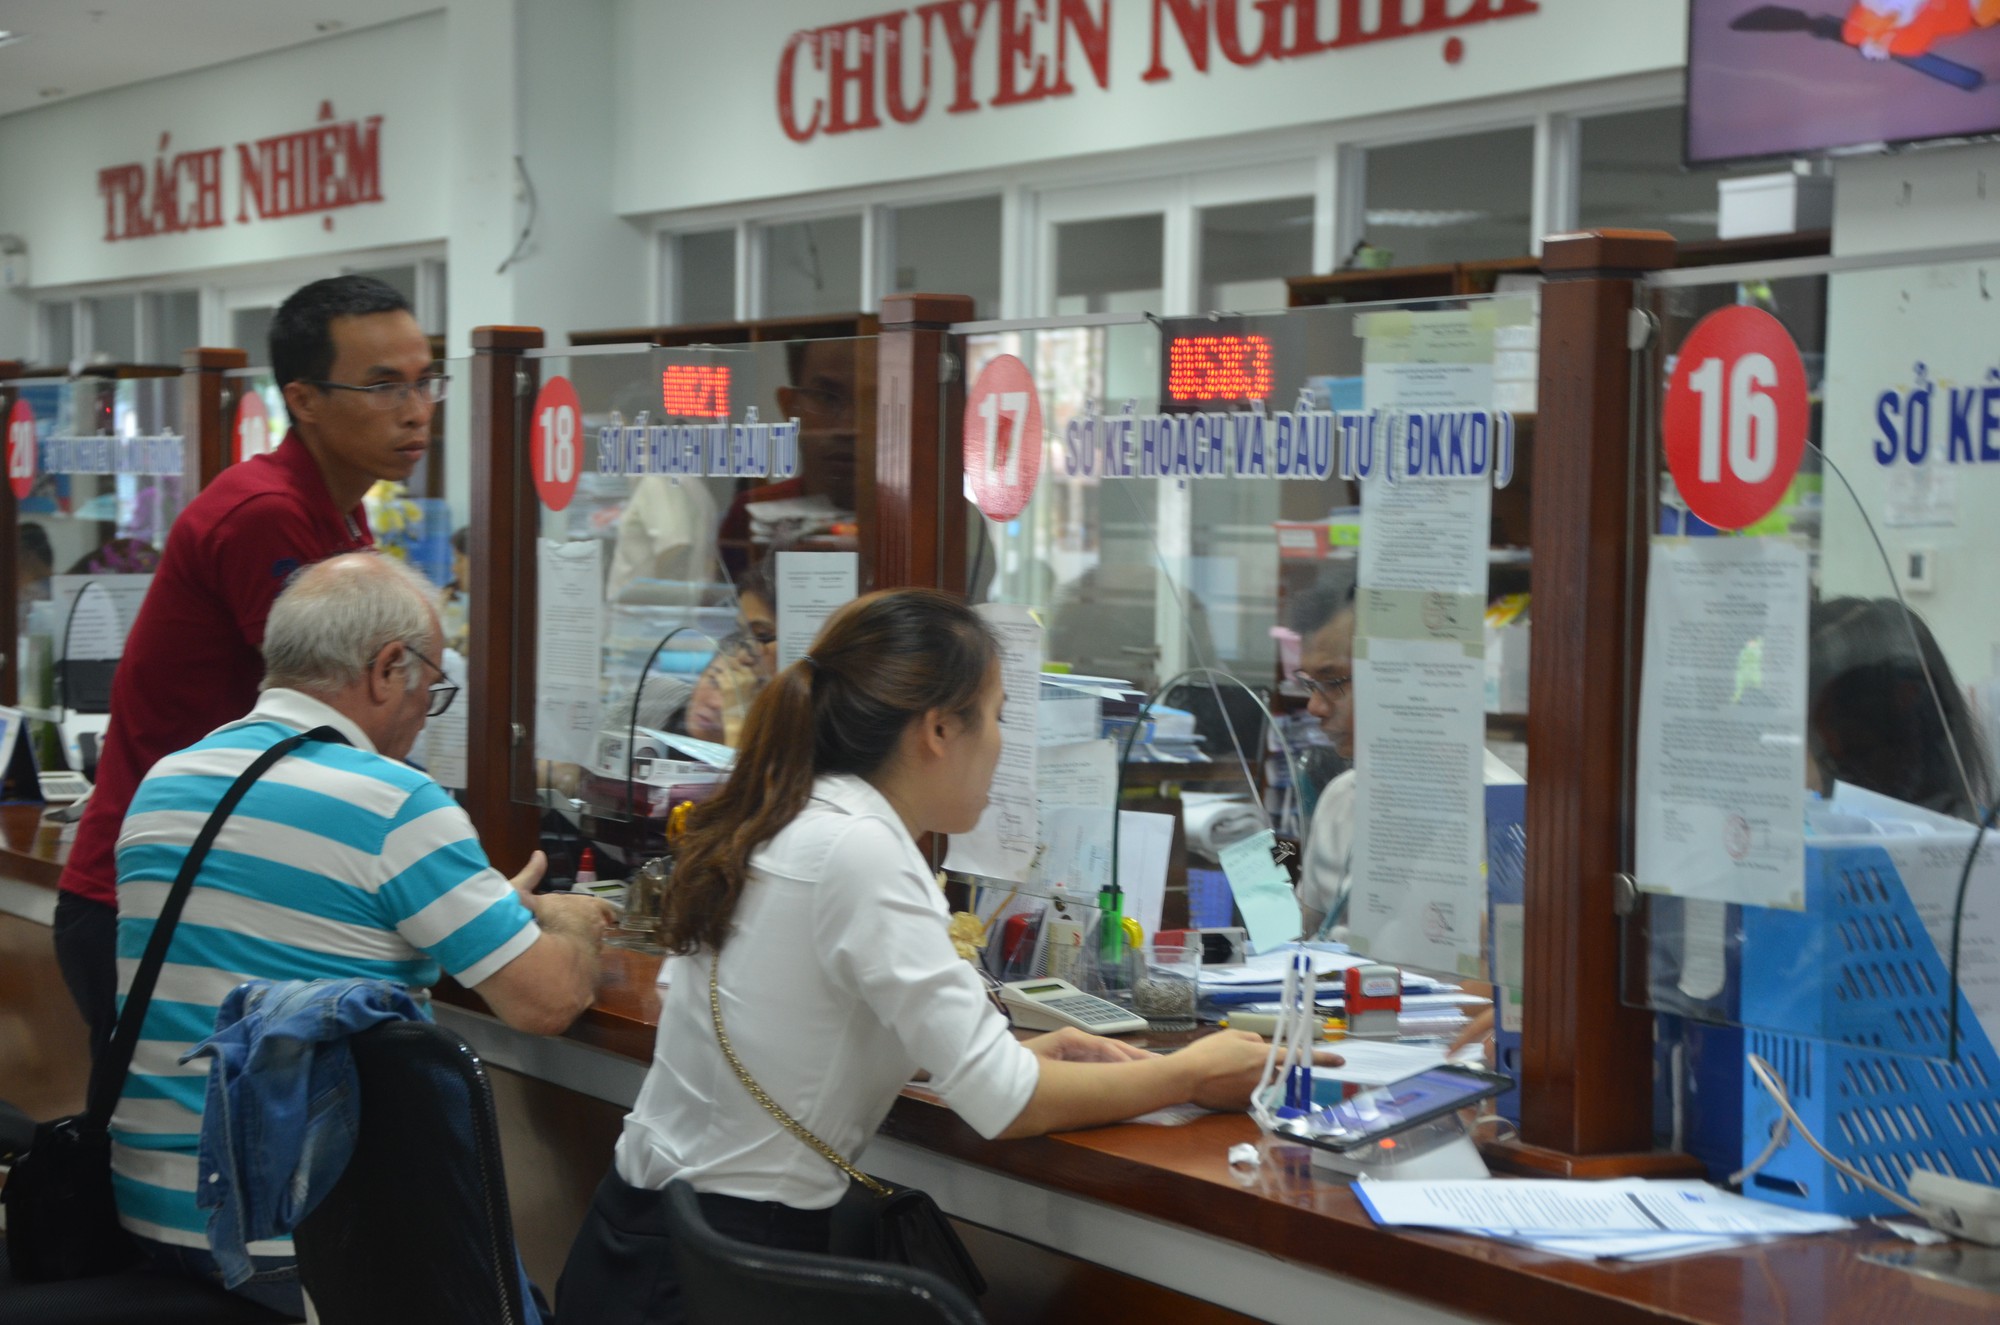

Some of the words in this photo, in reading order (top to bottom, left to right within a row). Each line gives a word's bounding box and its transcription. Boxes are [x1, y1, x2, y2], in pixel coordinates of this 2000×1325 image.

[97, 130, 225, 243] TRÁCH
[234, 99, 385, 233] NHIỆM
[9, 420, 32, 479] 20
[540, 405, 575, 483] 18
[977, 390, 1029, 487] 17
[1101, 398, 1138, 479] KẾ
[1139, 412, 1228, 490] HOẠCH
[1231, 398, 1269, 479] VÀ
[1273, 387, 1333, 481] ĐẦU
[1688, 352, 1779, 485] 16
[1873, 360, 1934, 466] SỞ
